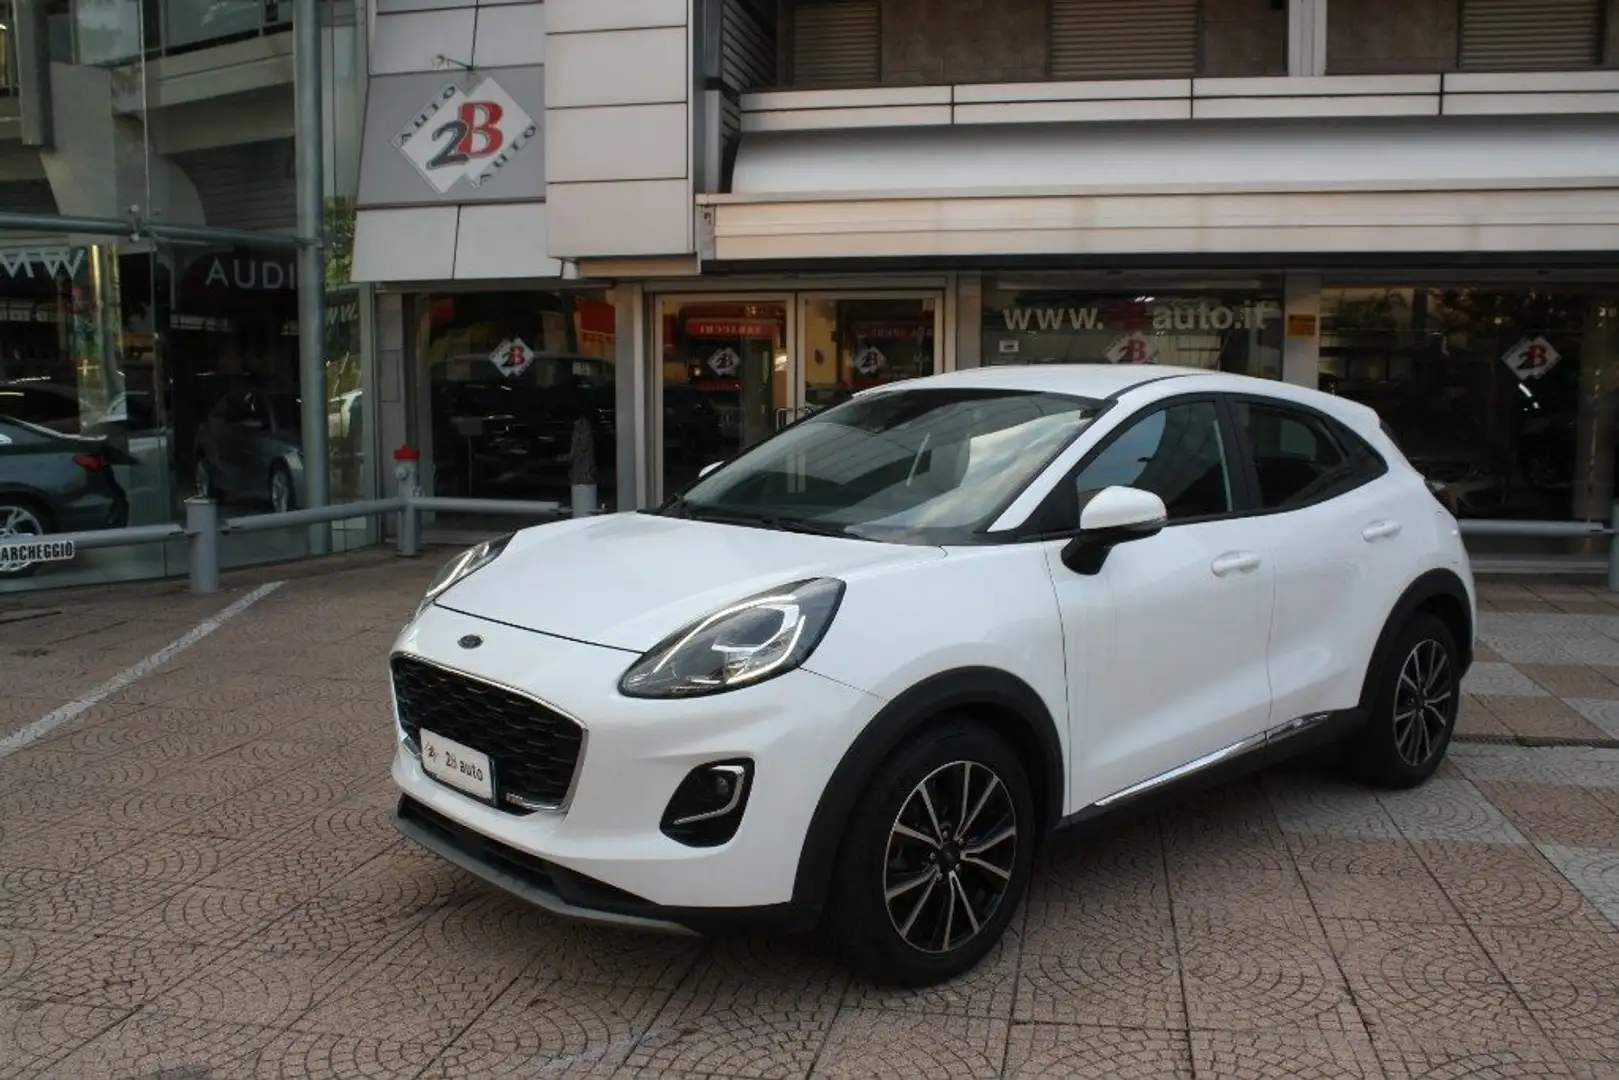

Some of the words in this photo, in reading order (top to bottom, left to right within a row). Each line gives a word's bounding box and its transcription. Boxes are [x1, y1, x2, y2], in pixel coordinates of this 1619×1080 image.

[399, 85, 456, 147] AUTO
[426, 101, 504, 170] 2B
[478, 125, 537, 187] AUTO
[205, 257, 296, 289] AUDI
[1, 541, 74, 561] ARCHEGGIO
[459, 760, 484, 782] auto
